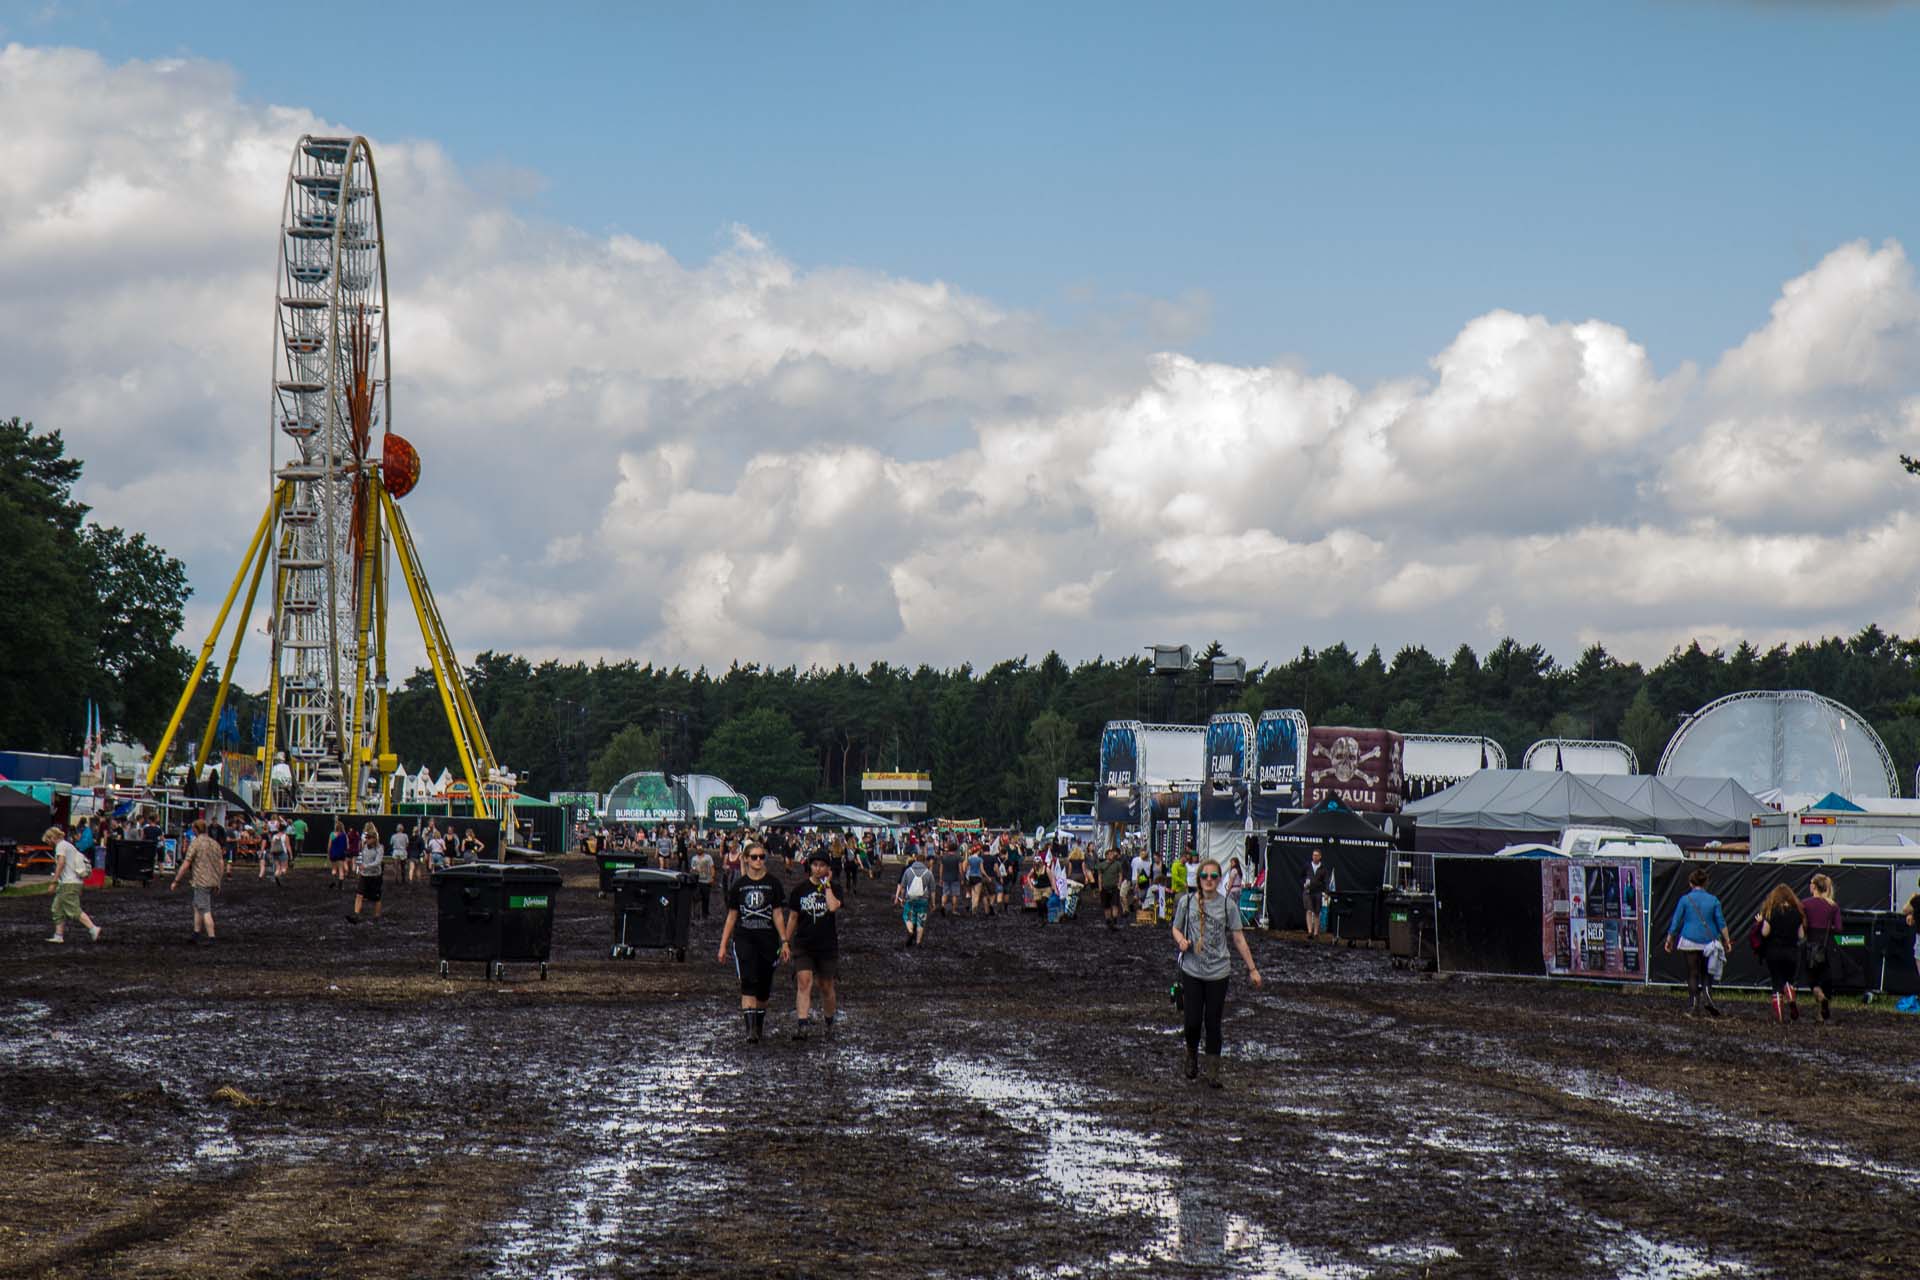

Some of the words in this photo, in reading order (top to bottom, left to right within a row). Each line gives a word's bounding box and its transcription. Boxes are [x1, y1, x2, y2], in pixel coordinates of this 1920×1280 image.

[1211, 754, 1233, 772] FLAMM
[1260, 764, 1295, 783] BAGUETTE
[615, 808, 645, 818] BURGER
[653, 808, 686, 818] POMMES
[714, 808, 738, 818] PASTA
